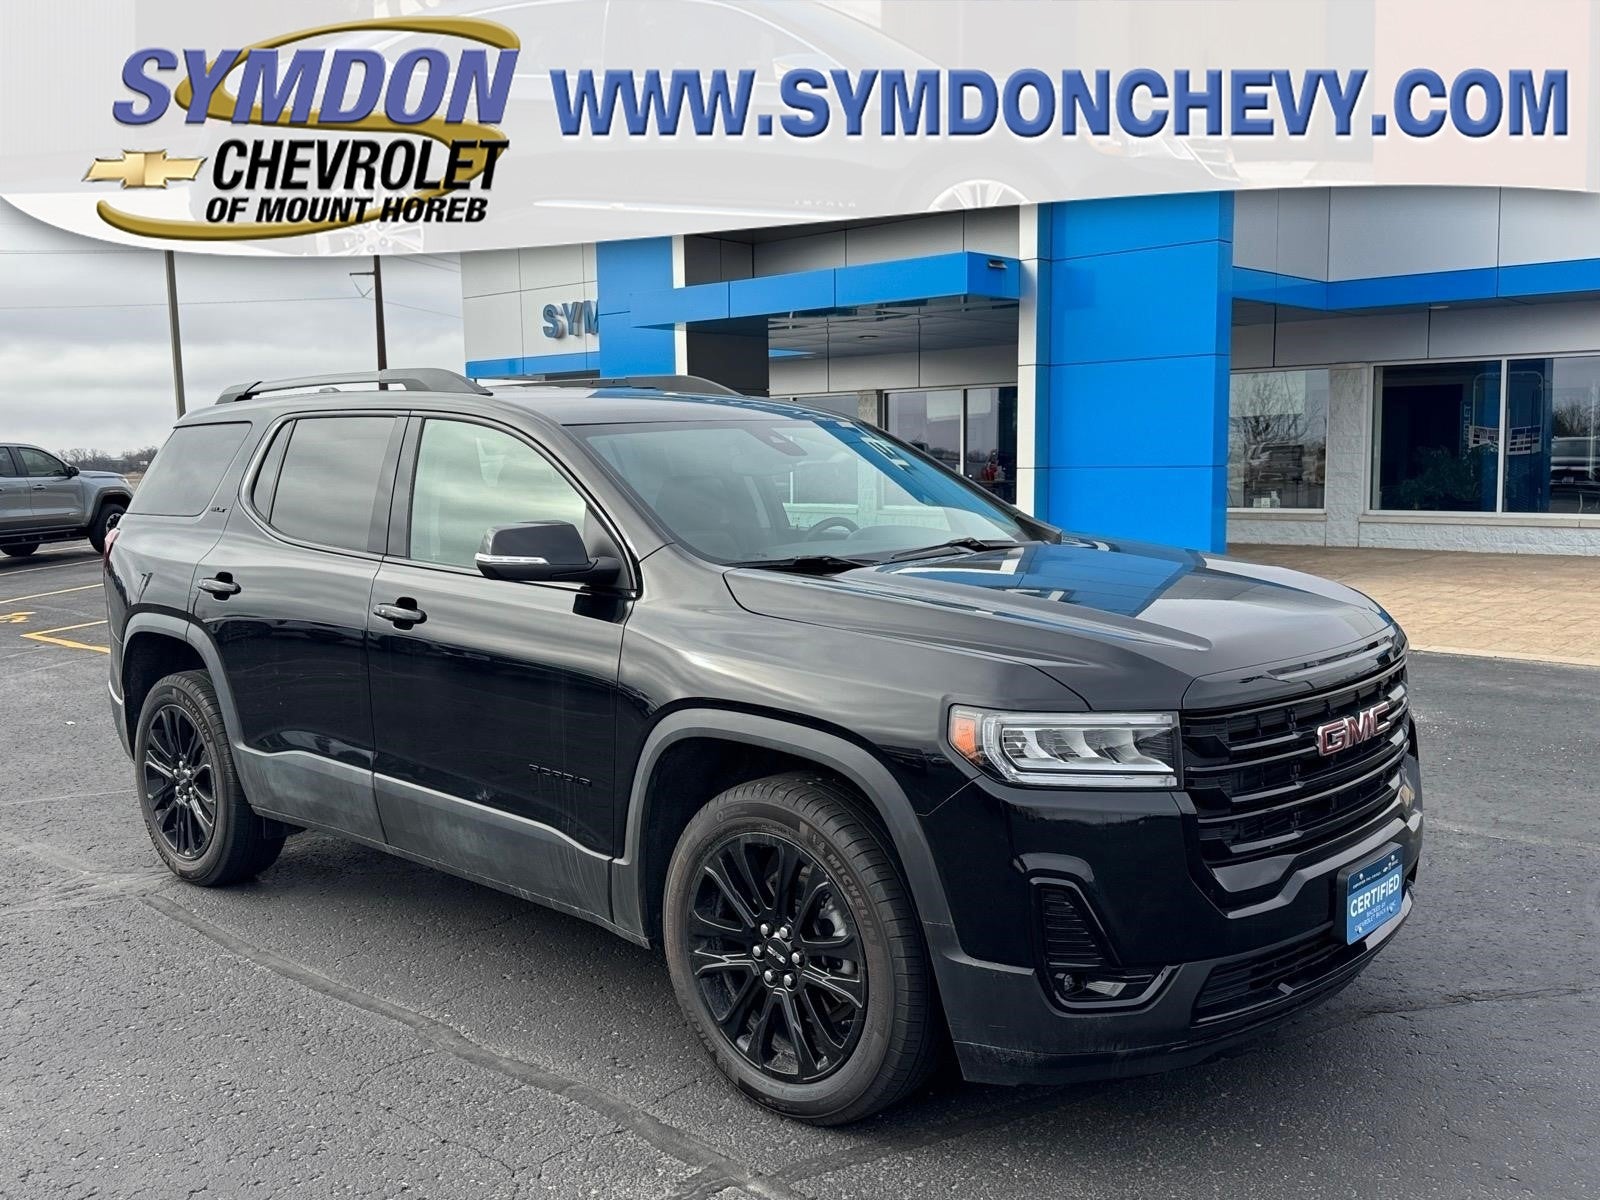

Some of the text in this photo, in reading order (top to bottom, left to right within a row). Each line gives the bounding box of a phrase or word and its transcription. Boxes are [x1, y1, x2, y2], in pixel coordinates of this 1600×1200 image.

[1317, 701, 1391, 757] GMC
[825, 853, 879, 944] MICHELIN
[1350, 873, 1400, 917] CERTIFIED
